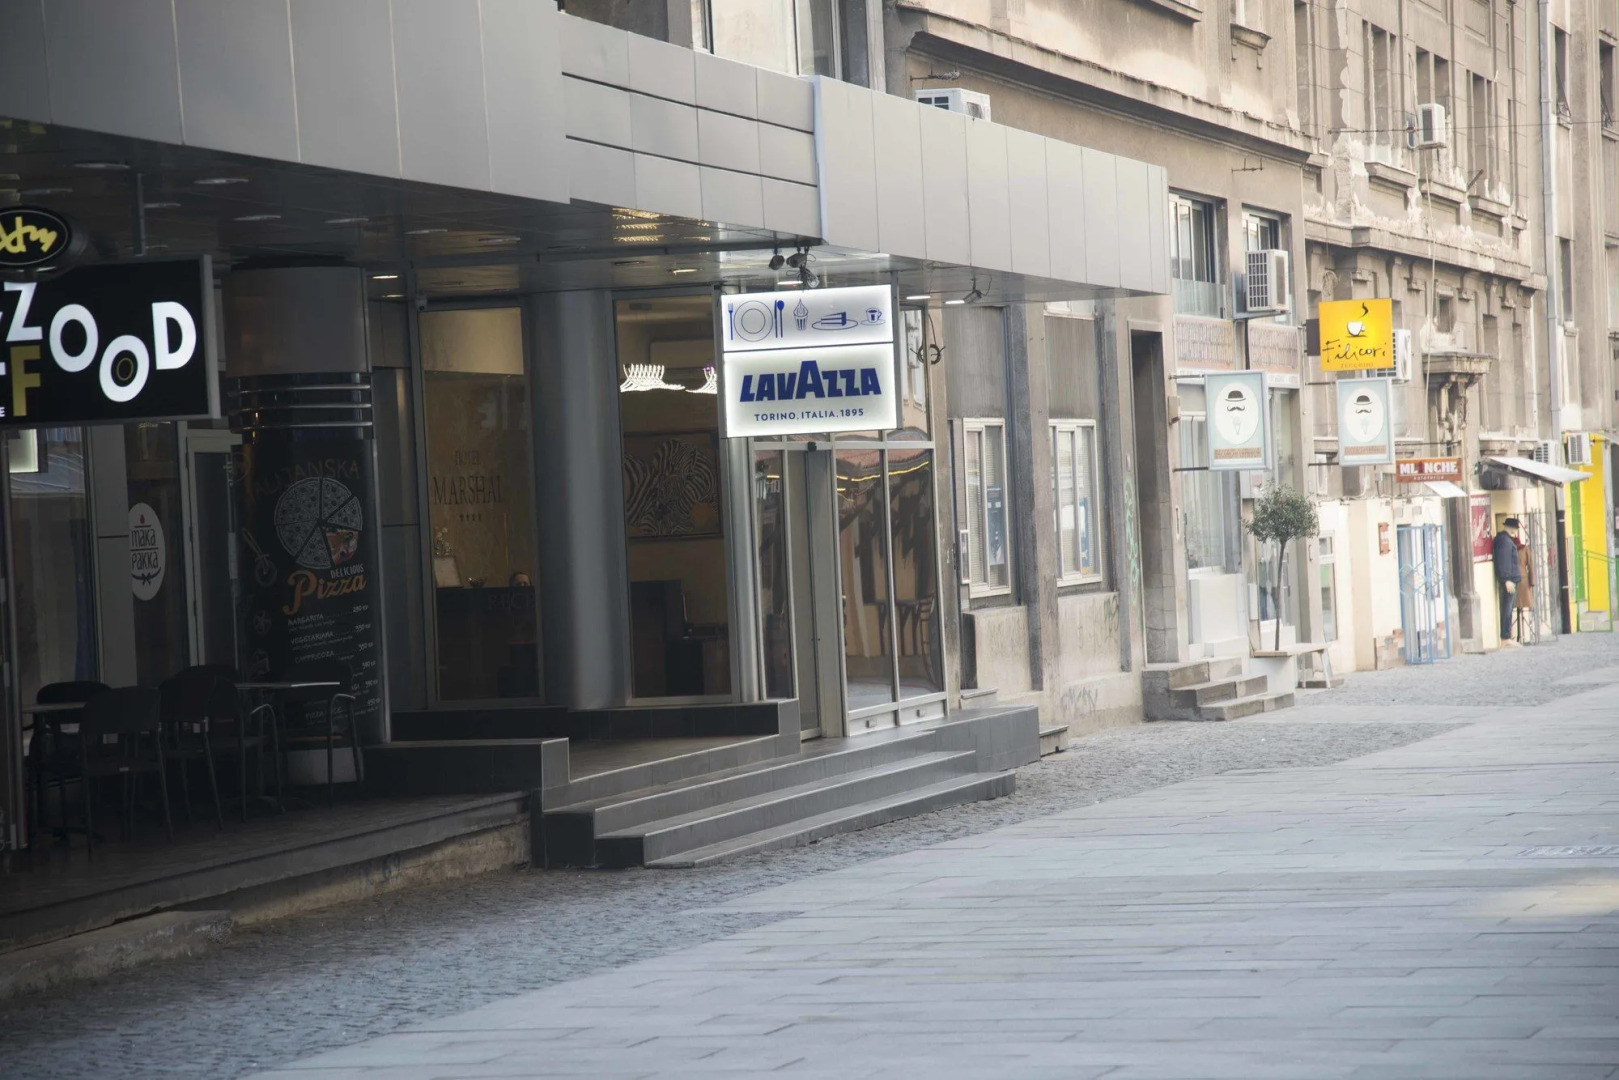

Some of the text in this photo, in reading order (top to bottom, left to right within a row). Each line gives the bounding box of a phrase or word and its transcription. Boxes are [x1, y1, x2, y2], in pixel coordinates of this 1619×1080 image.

[1322, 339, 1389, 363] Filicori
[740, 360, 882, 403] LAVAZZA
[840, 408, 864, 417] 1895
[281, 569, 368, 616] Pizza
